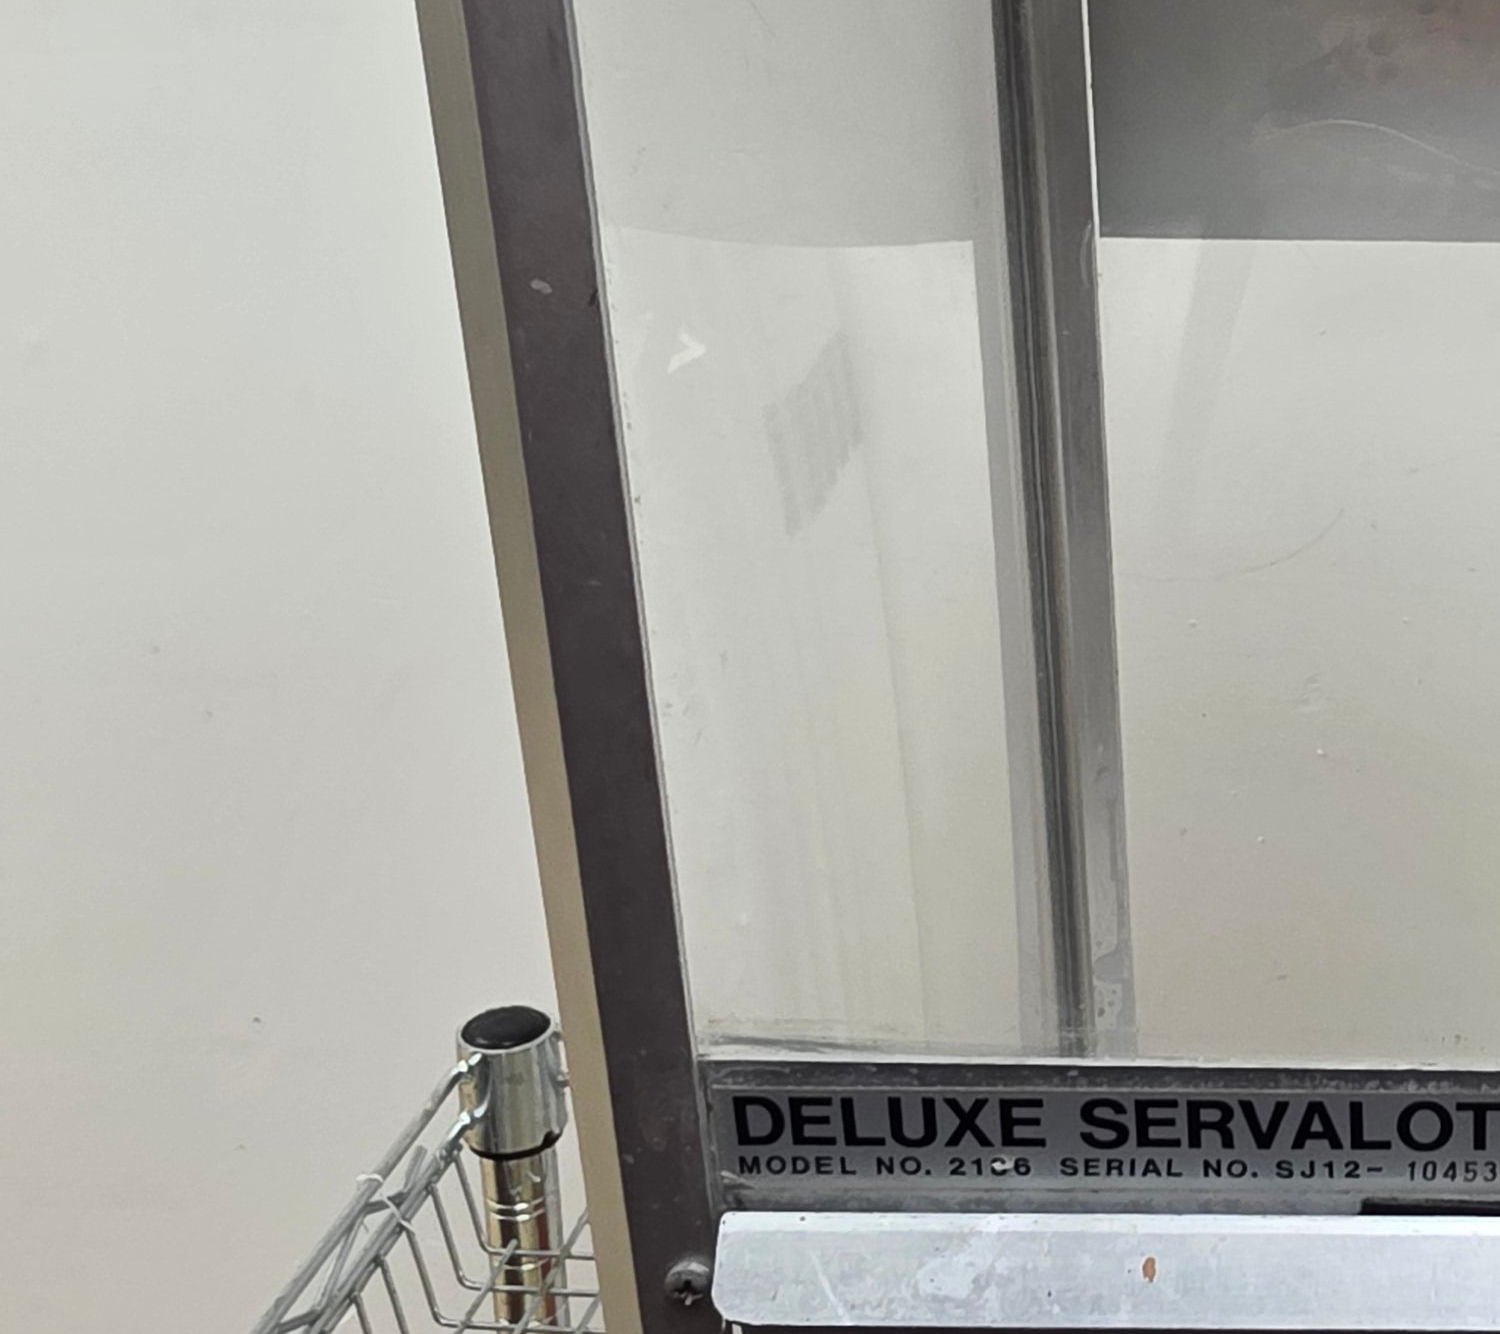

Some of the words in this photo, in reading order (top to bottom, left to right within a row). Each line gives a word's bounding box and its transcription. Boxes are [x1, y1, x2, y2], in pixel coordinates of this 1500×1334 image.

[732, 1096, 1047, 1148] DELUXE
[738, 1155, 857, 1175] MODEL
[876, 1156, 931, 1176] NO.
[1059, 1157, 1183, 1178] SERIAL
[1203, 1159, 1259, 1179] NO.
[1407, 1161, 1498, 1183] 10453
